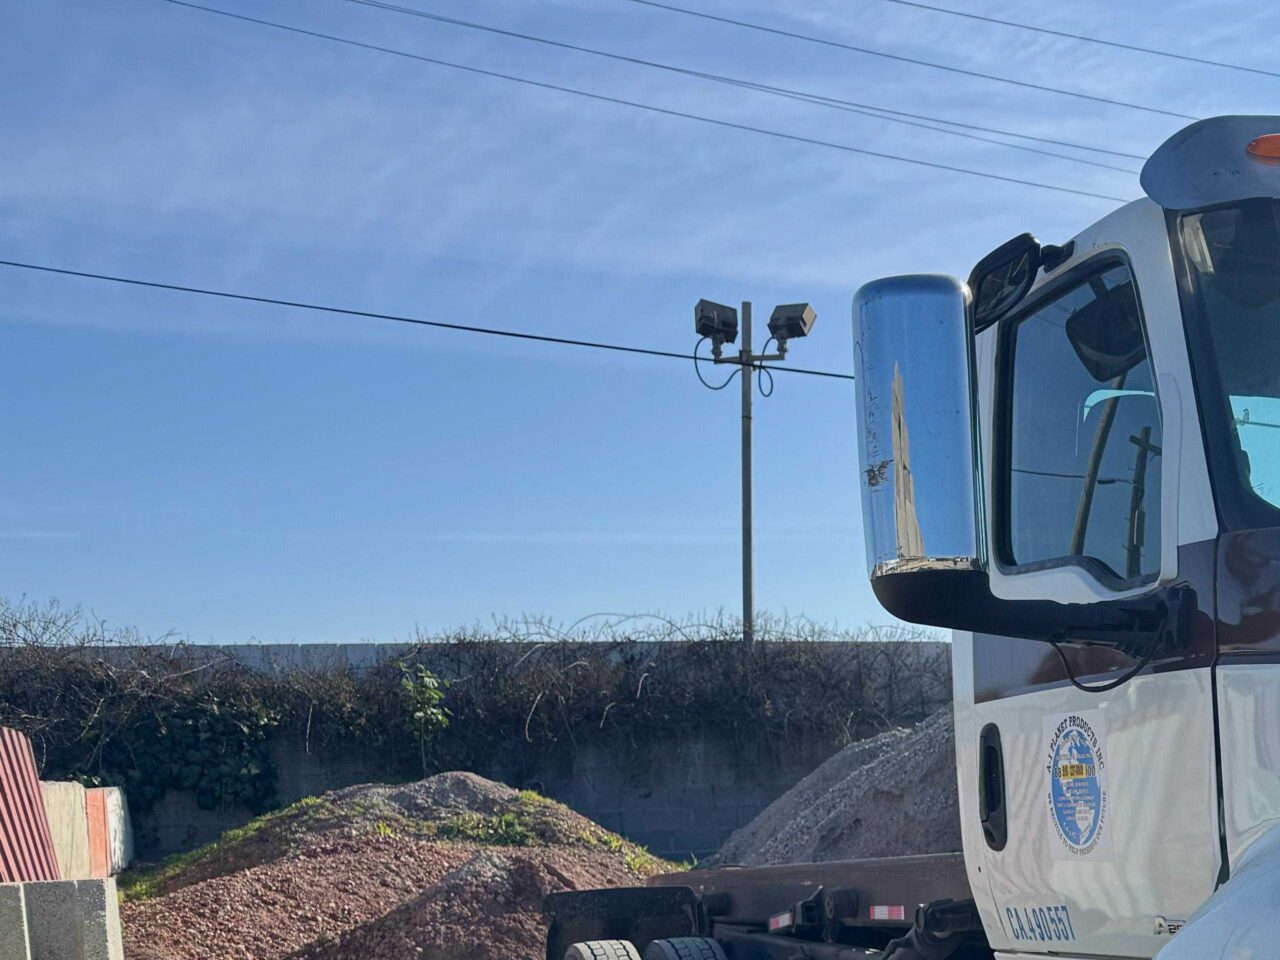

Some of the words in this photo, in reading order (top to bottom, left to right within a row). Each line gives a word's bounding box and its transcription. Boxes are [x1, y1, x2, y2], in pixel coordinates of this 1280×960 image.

[1049, 718, 1068, 752] PLANET
[1068, 715, 1098, 748] PRODUCTS
[1095, 747, 1105, 771] INC
[1006, 905, 1075, 942] CA.490557
